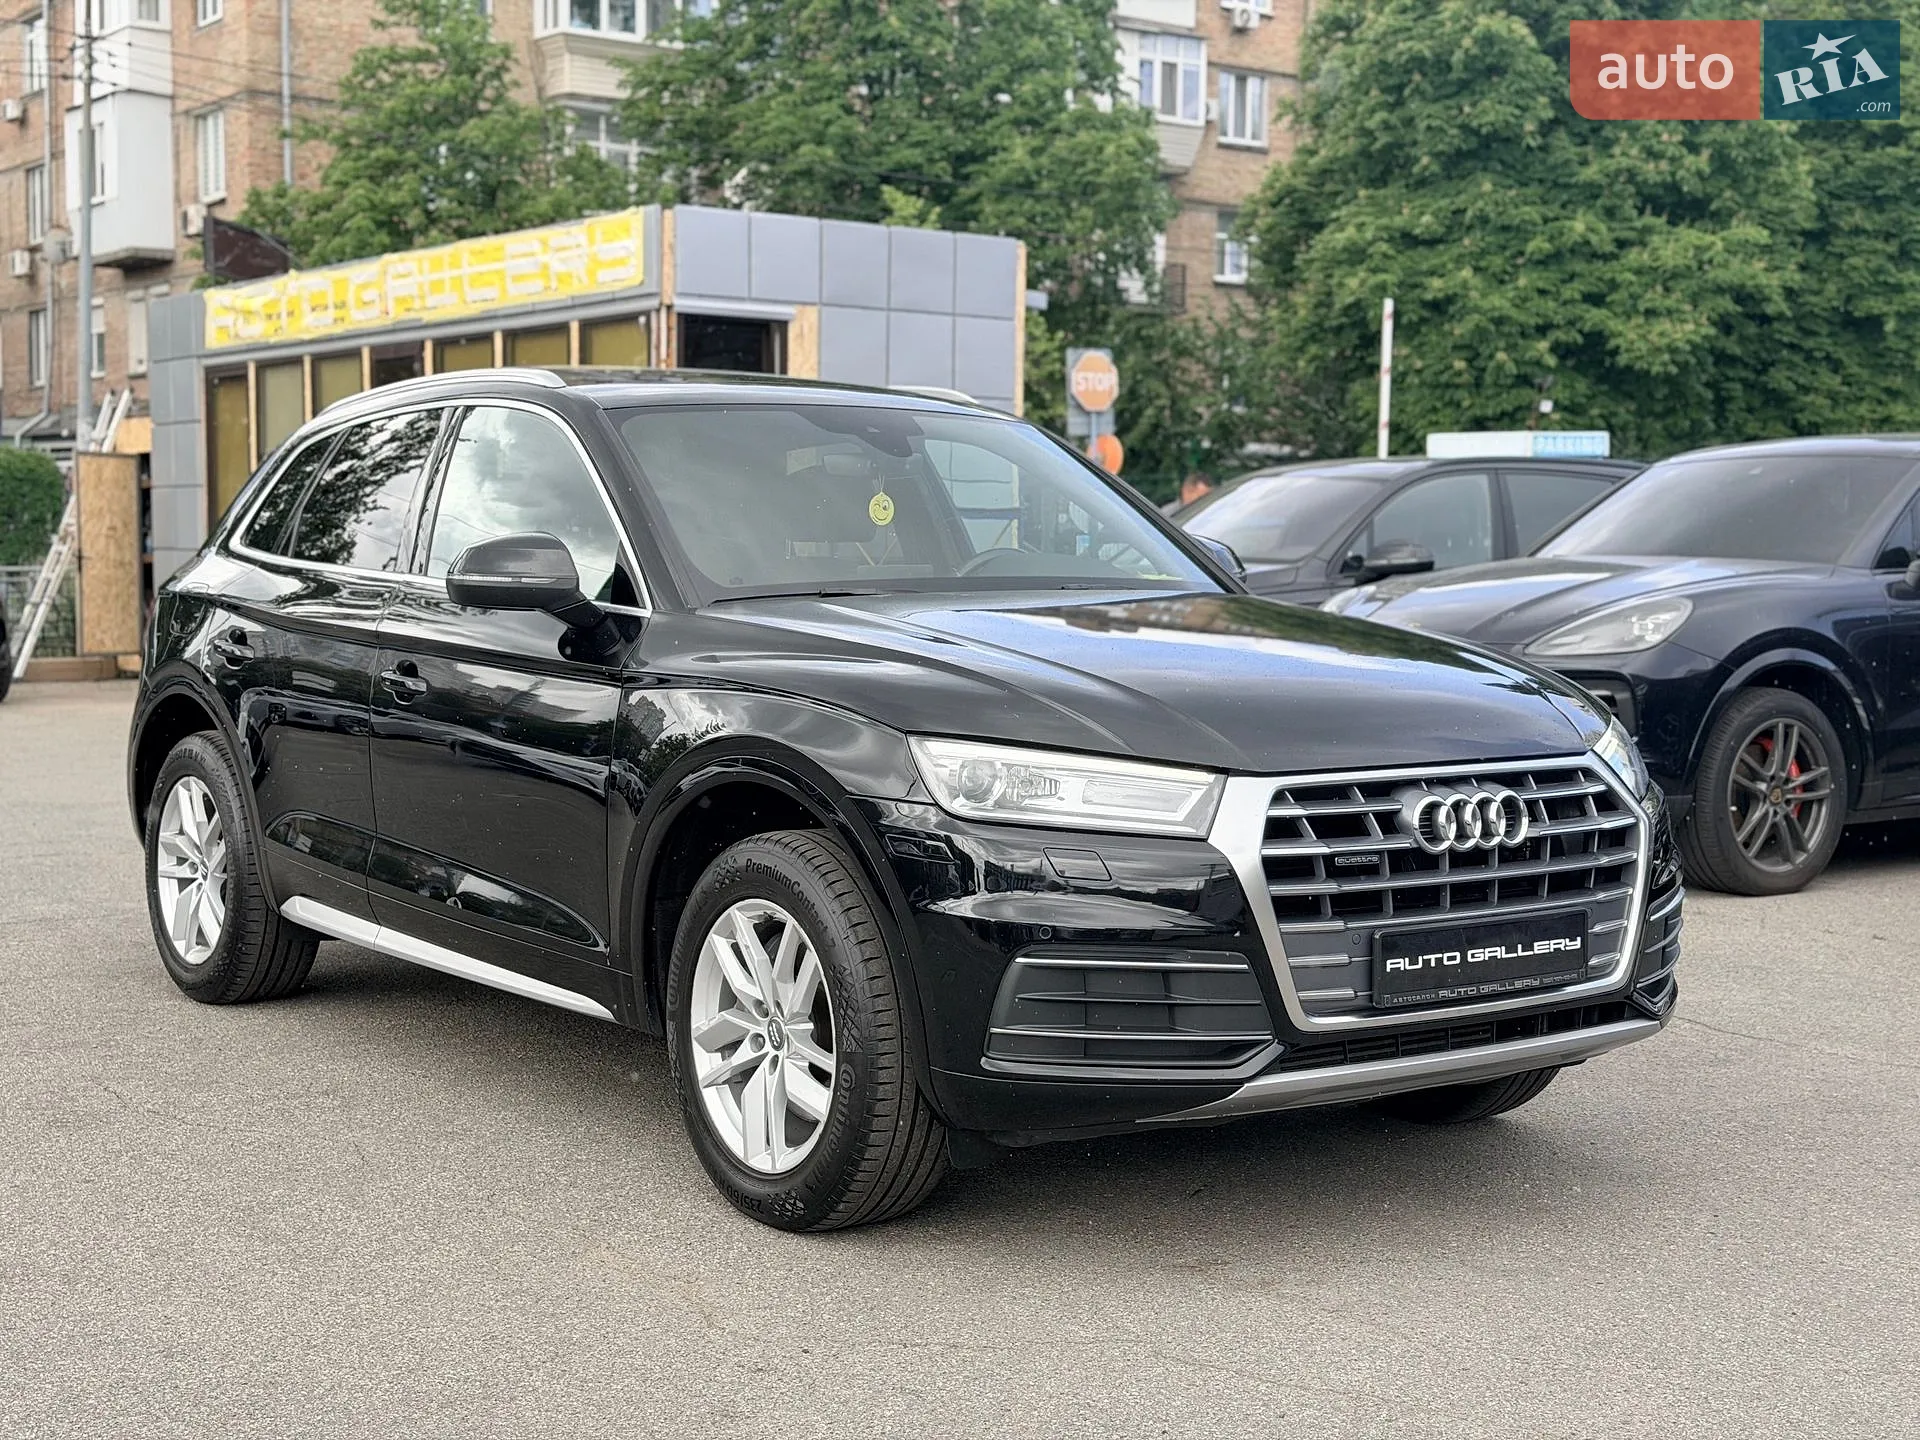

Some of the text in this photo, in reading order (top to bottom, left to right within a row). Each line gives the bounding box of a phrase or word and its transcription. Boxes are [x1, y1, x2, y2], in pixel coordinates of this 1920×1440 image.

[1076, 371, 1115, 393] STOP
[1337, 856, 1379, 864] quattro
[1386, 937, 1581, 972] AUTO GALLERY
[1439, 987, 1477, 998] AUTO
[1480, 977, 1540, 993] GALLERY
